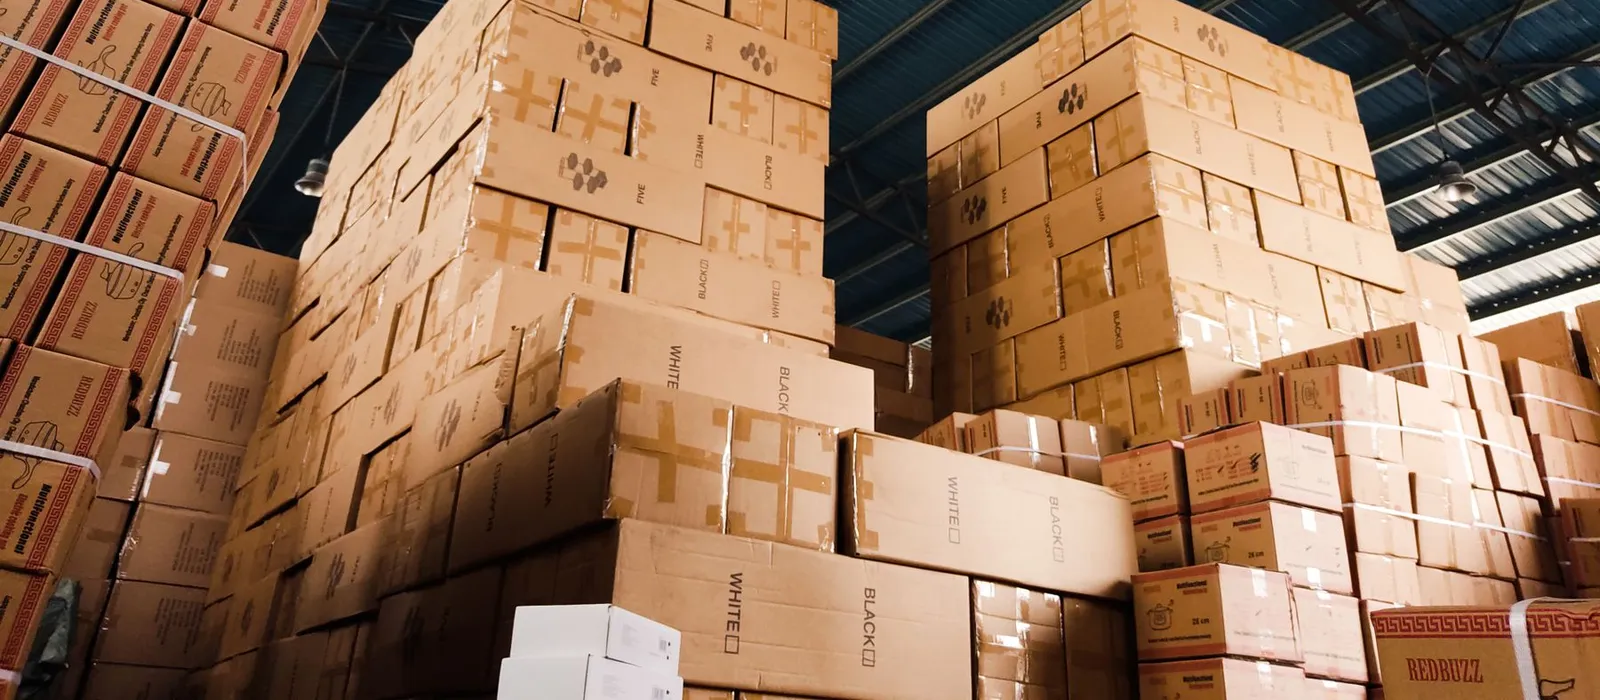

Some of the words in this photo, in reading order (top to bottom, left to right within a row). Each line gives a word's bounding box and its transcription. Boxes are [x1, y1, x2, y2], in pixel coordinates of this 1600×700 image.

[86, 0, 116, 44] Multifunctiona
[705, 34, 714, 52] FIVE
[651, 68, 660, 87] FIVE
[42, 93, 69, 127] REDBUZZ
[193, 132, 222, 183] Multifunctional
[695, 134, 704, 159] WHITE
[764, 155, 773, 181] BLACK
[636, 183, 646, 205] FIVE
[112, 188, 143, 244] Multifunctional
[698, 270, 708, 300] BLACK
[772, 290, 780, 319] WHITE
[71, 301, 99, 340] REDBUZZ
[1113, 310, 1122, 339] BLACK
[667, 345, 682, 390] WHITE
[66, 375, 94, 417] REDBUZZ
[779, 366, 790, 412] BLACK
[14, 483, 52, 555] Multifunctional
[948, 476, 960, 526] WHITE
[1049, 496, 1063, 546] BLACK
[726, 572, 743, 632] WHITE
[863, 587, 876, 647] BLACK
[1406, 658, 1484, 684] REDBUZZ
